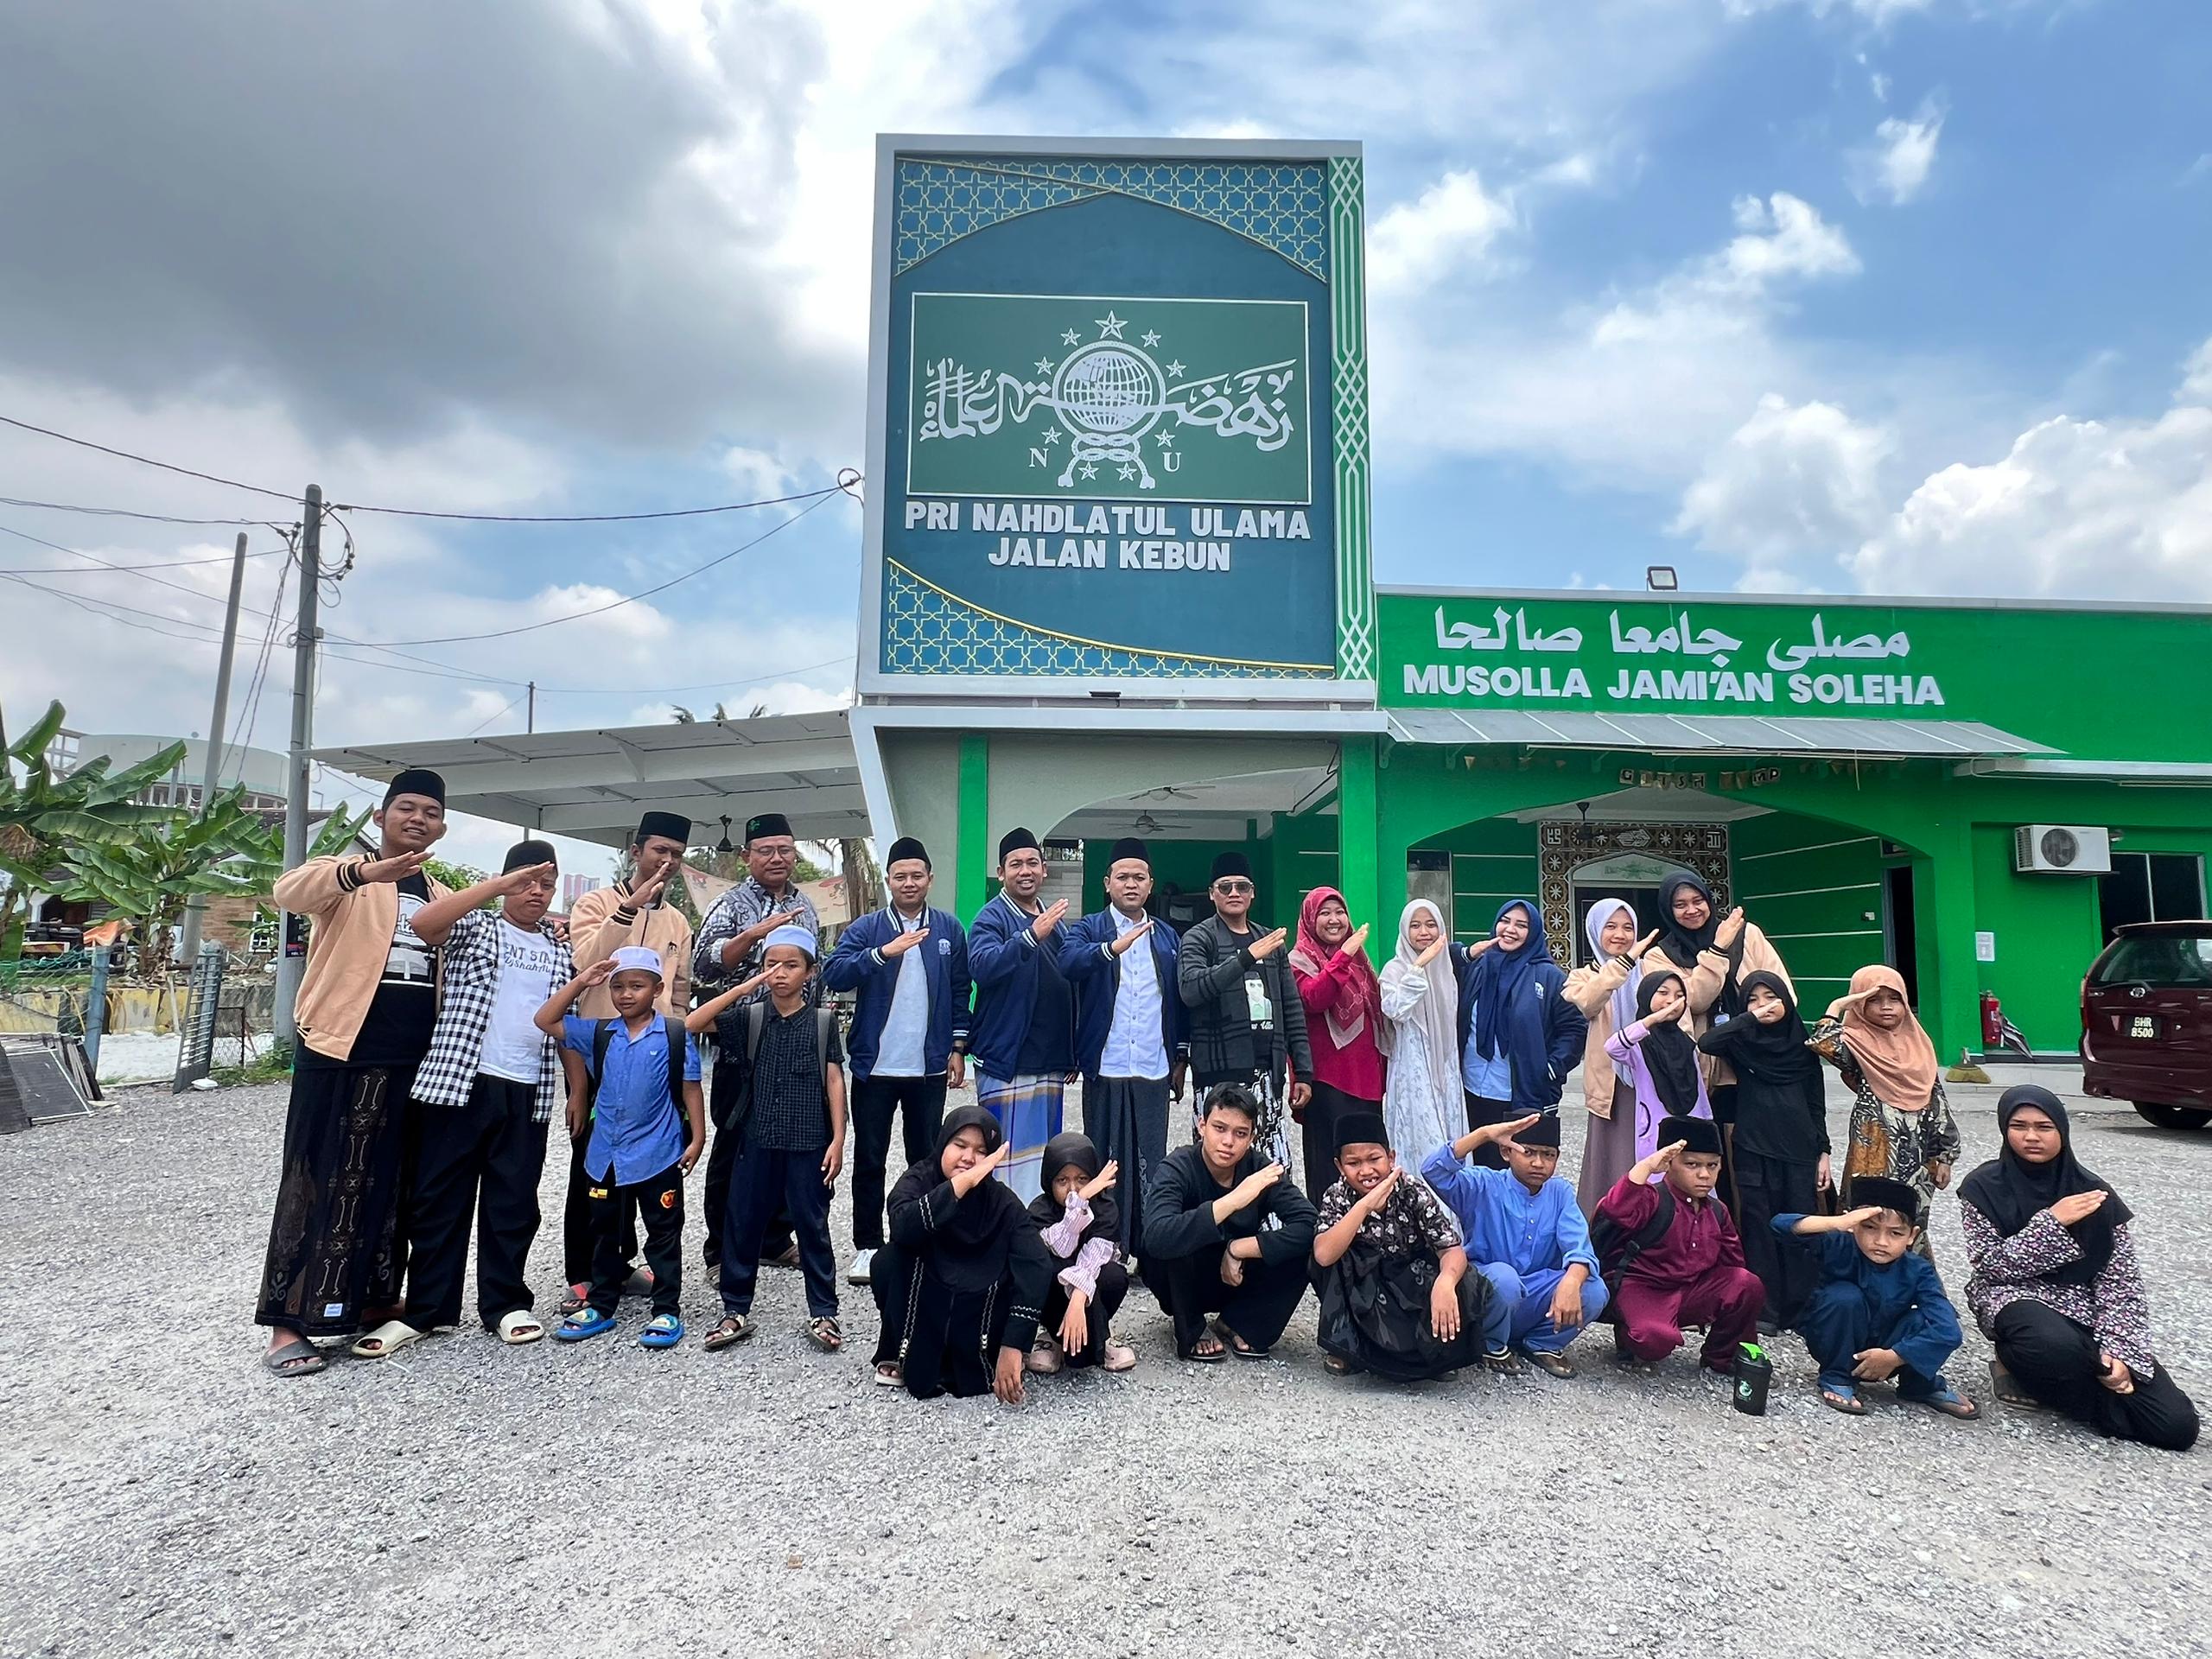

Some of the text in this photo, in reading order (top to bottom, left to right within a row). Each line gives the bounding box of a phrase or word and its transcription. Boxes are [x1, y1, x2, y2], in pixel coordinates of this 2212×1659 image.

[1029, 448, 1181, 472] N U
[905, 501, 1312, 539] PRI NAHDLATUL ULAMA
[988, 537, 1230, 571] JALAN KEBUN
[1403, 664, 1592, 698] MUSOLLA
[1788, 673, 1945, 705] SOLEHA
[2131, 1027, 2154, 1038] 8500
